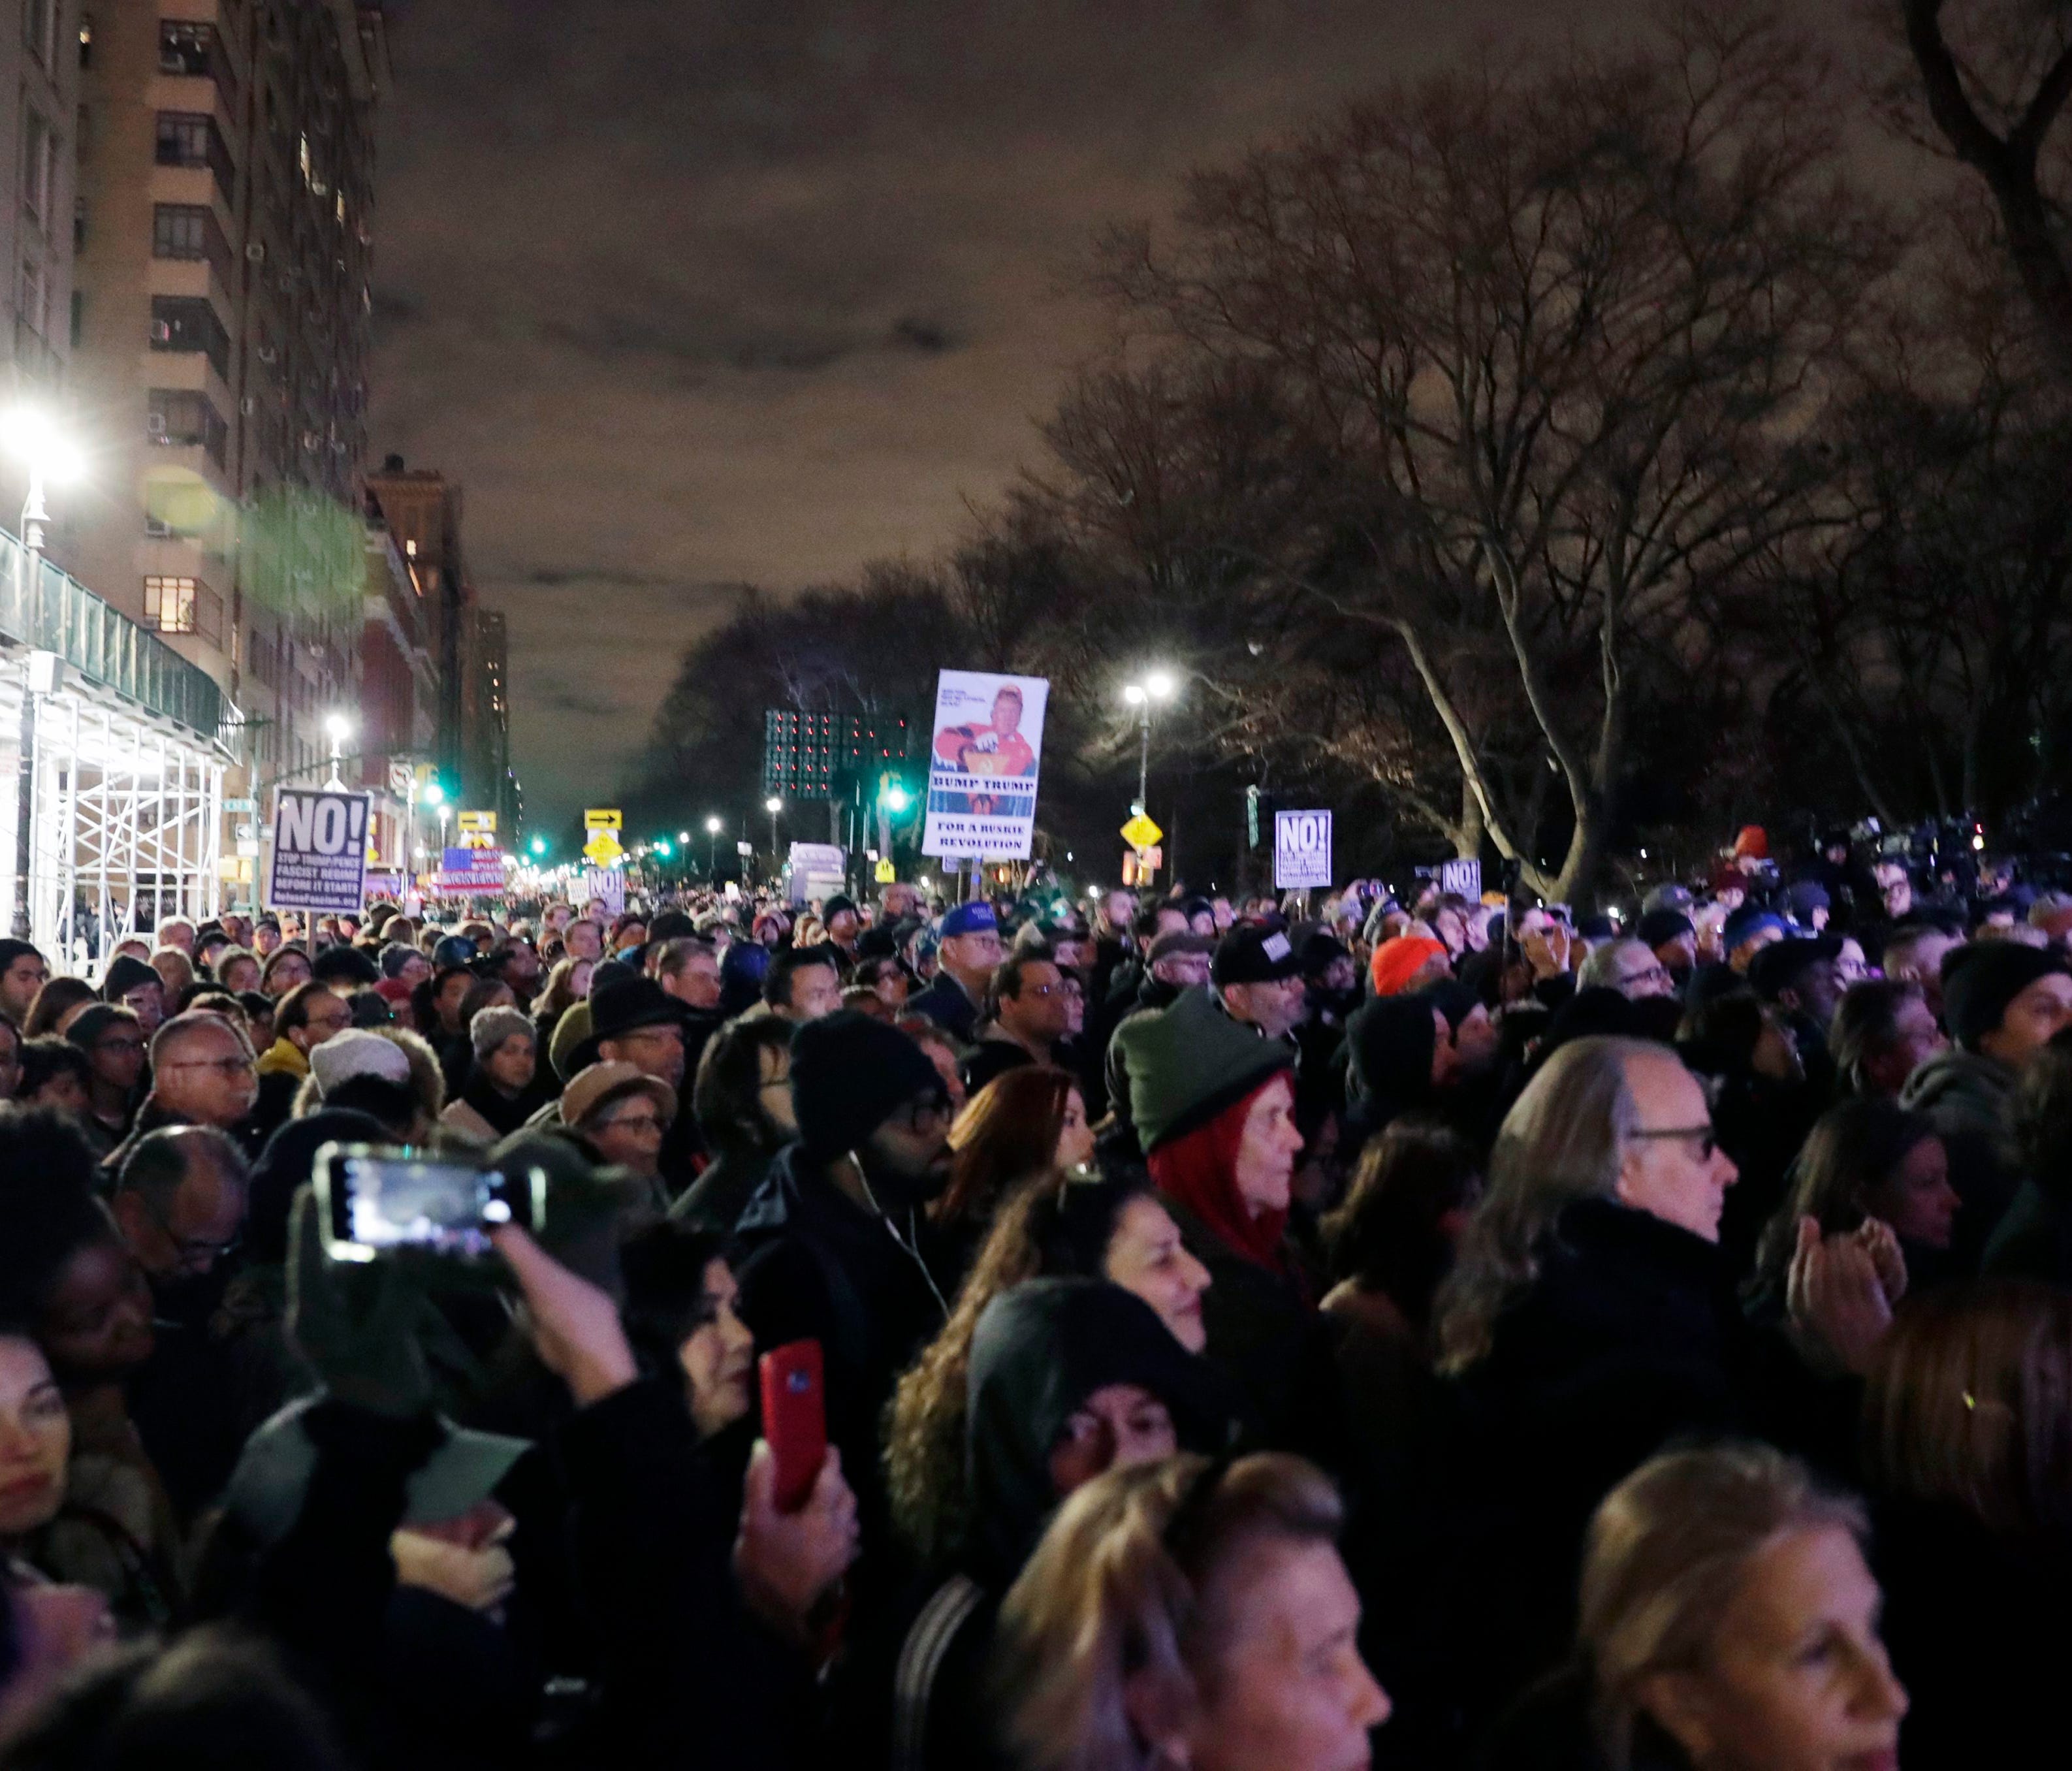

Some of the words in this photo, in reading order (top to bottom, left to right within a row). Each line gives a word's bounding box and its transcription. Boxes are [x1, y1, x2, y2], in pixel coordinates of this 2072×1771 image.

[984, 780, 1034, 791] TRUMP
[278, 795, 364, 855] NO!
[937, 822, 964, 831] FOR
[969, 823, 976, 833] A
[1280, 816, 1326, 852] NO!
[940, 838, 1022, 849] REVOLUTION
[277, 852, 300, 864] STOP
[276, 865, 319, 878] FASCIST
[320, 867, 359, 880] REGIME
[1446, 862, 1477, 889] NO!
[276, 877, 312, 890] BEFORE
[313, 882, 323, 893] IT
[323, 882, 359, 894] STARTS
[590, 870, 621, 893] NO!
